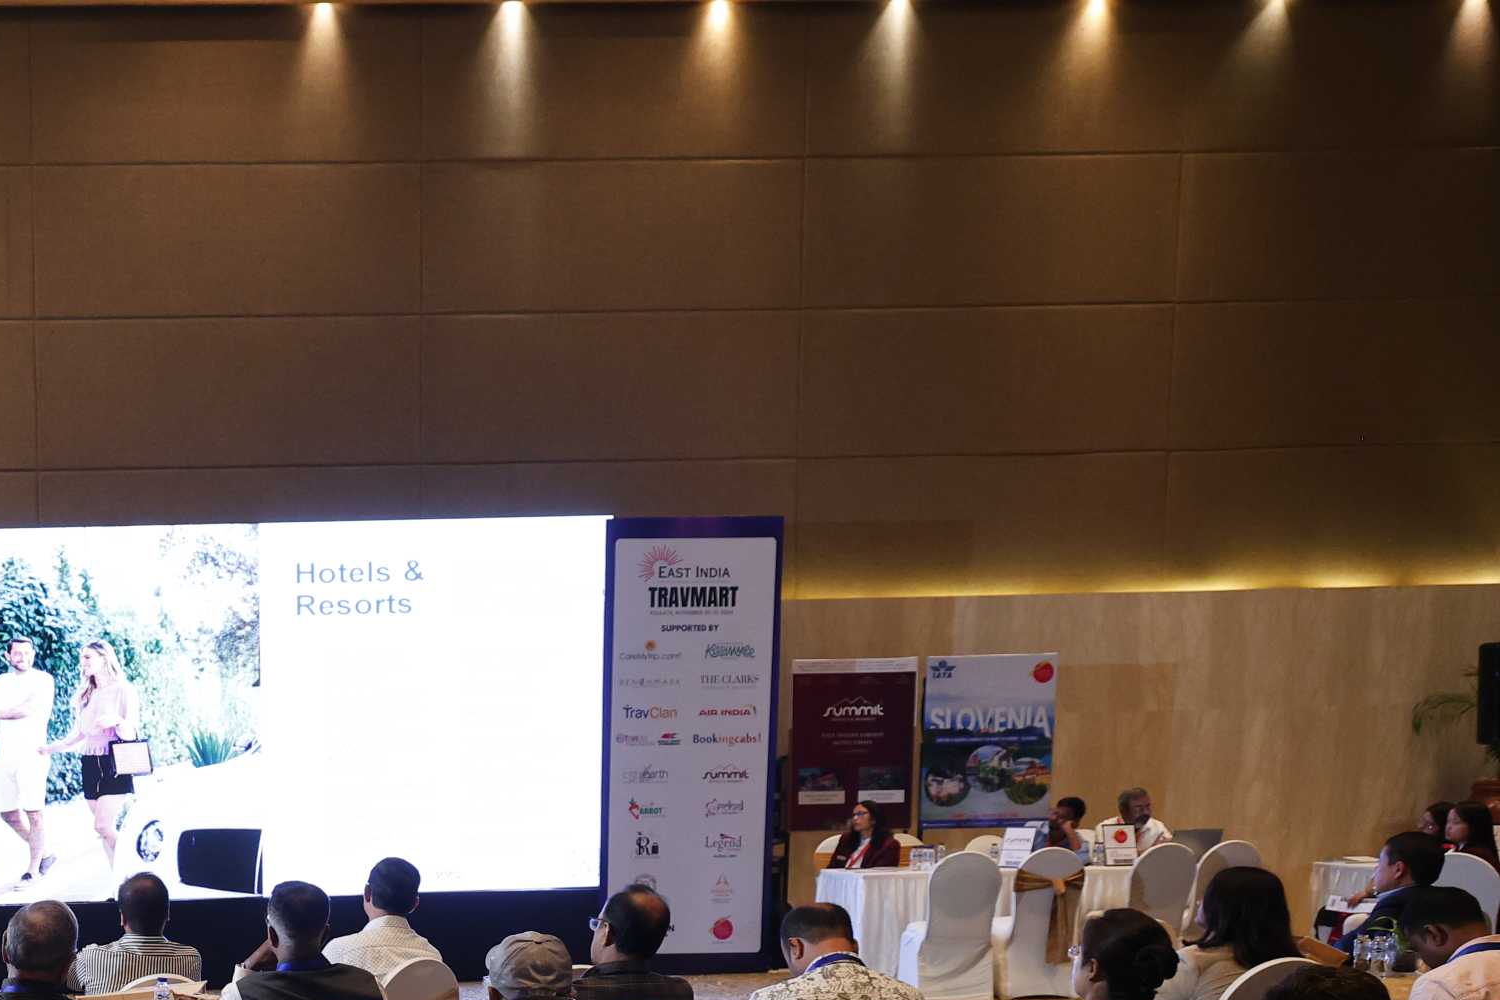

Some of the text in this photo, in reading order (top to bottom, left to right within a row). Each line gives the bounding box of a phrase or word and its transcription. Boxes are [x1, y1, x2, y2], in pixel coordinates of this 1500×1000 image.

[297, 560, 423, 584] Hotels &
[658, 566, 730, 579] EAST INDIA
[649, 586, 739, 607] TRAVMART
[297, 595, 412, 616] Resorts
[661, 624, 719, 632] SUPPORTED BY
[623, 704, 678, 721] TravClan
[698, 708, 752, 717] AIR INDIA
[823, 703, 885, 718] summit
[929, 703, 1052, 738] SLOVENIA
[701, 769, 750, 780] summit
